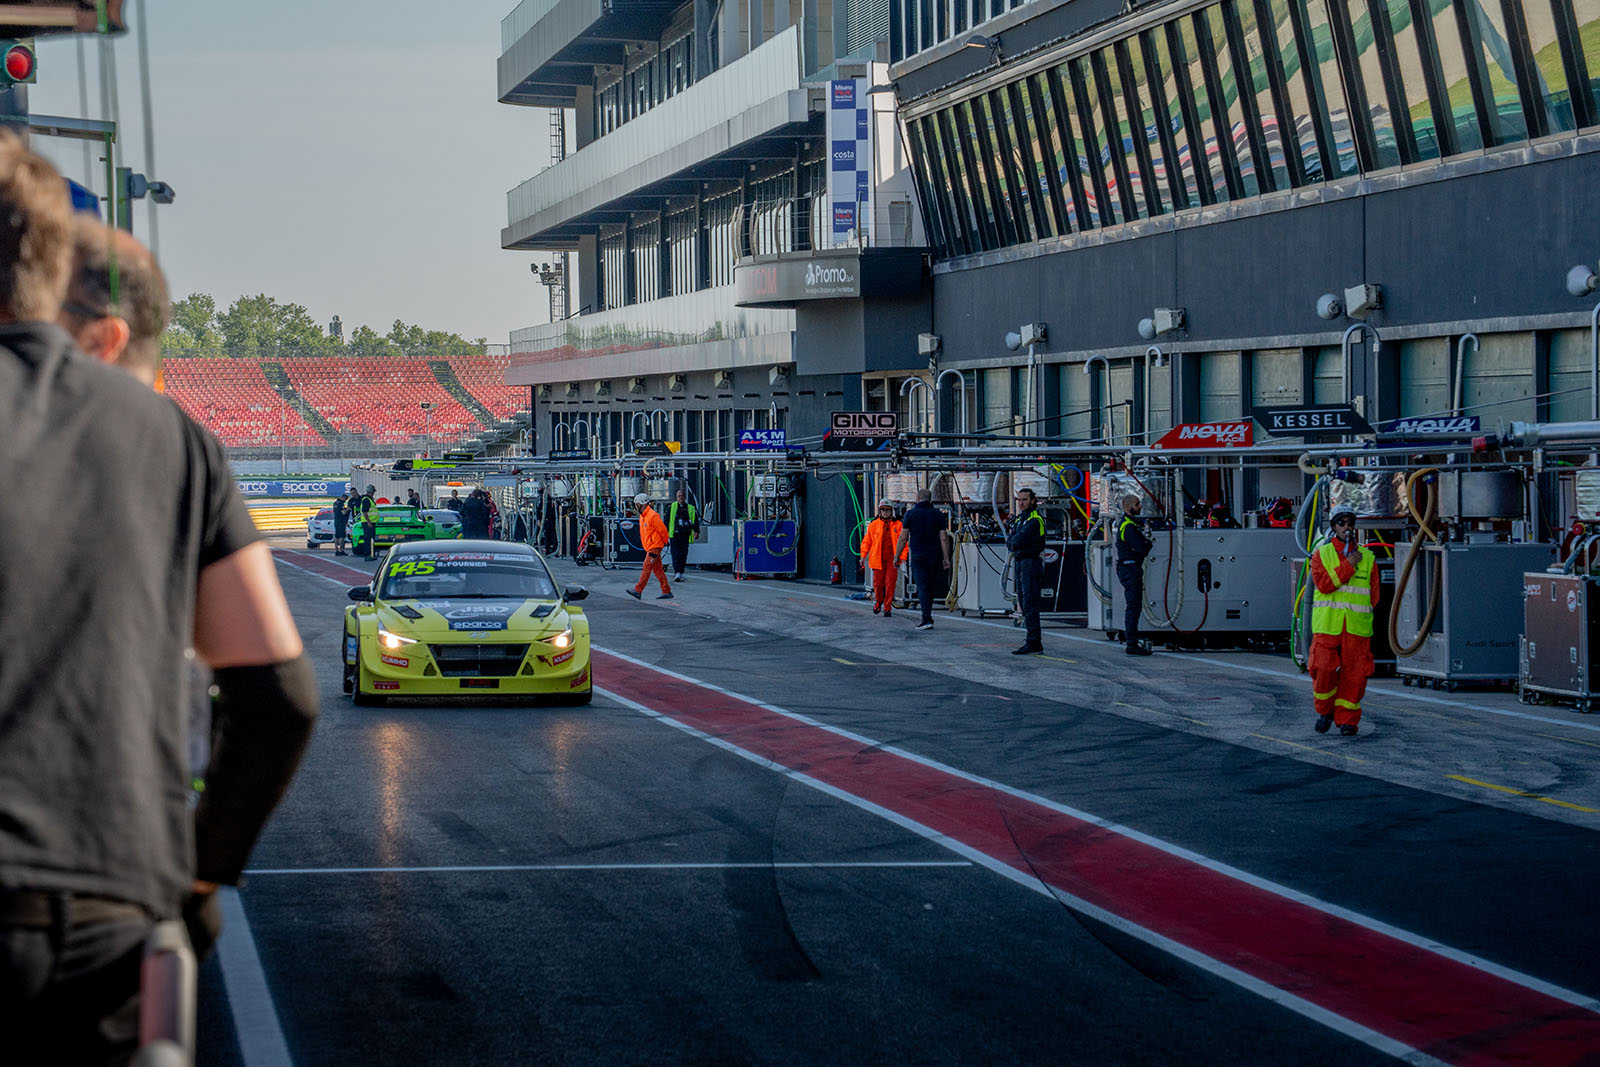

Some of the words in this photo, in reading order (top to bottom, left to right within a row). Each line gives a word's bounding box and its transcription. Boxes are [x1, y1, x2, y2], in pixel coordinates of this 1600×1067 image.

[815, 264, 846, 283] Promo
[833, 414, 896, 428] GINO
[1273, 413, 1346, 427] KESSEL
[1395, 418, 1475, 433] NOVA
[1178, 425, 1249, 439] NOVA
[237, 482, 268, 491] arco
[282, 482, 328, 493] sparco
[389, 561, 436, 576] 145
[453, 621, 502, 629] sparco
[382, 655, 408, 667] KUMHO
